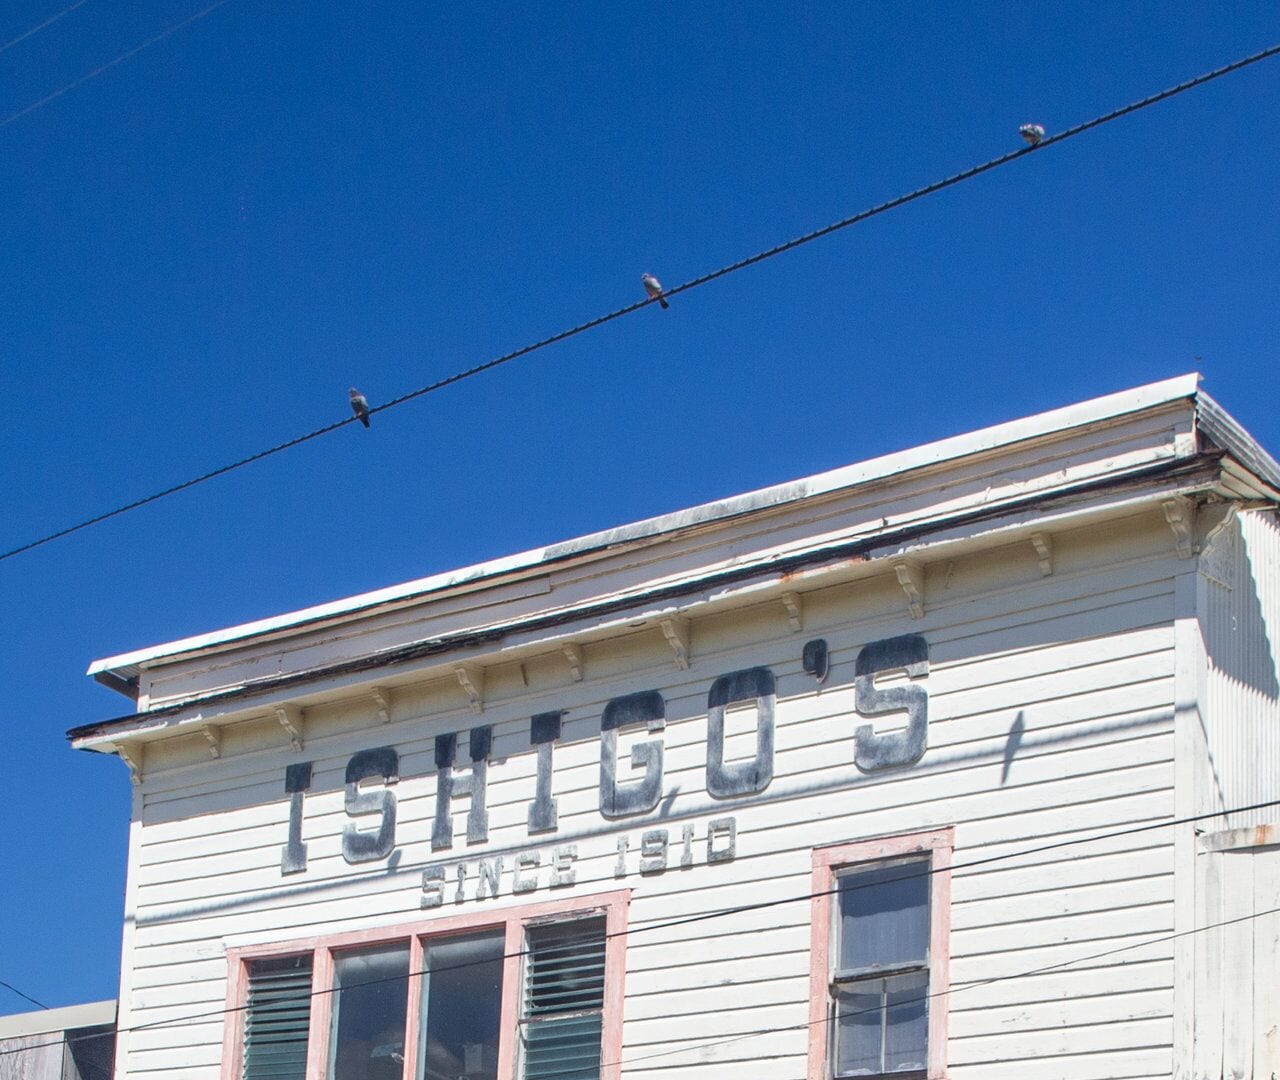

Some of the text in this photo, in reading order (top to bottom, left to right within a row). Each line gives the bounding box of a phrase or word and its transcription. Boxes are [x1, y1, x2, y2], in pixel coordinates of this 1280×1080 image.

[281, 633, 930, 875] ISHIGO'S
[420, 816, 737, 909] SINCE 1910
